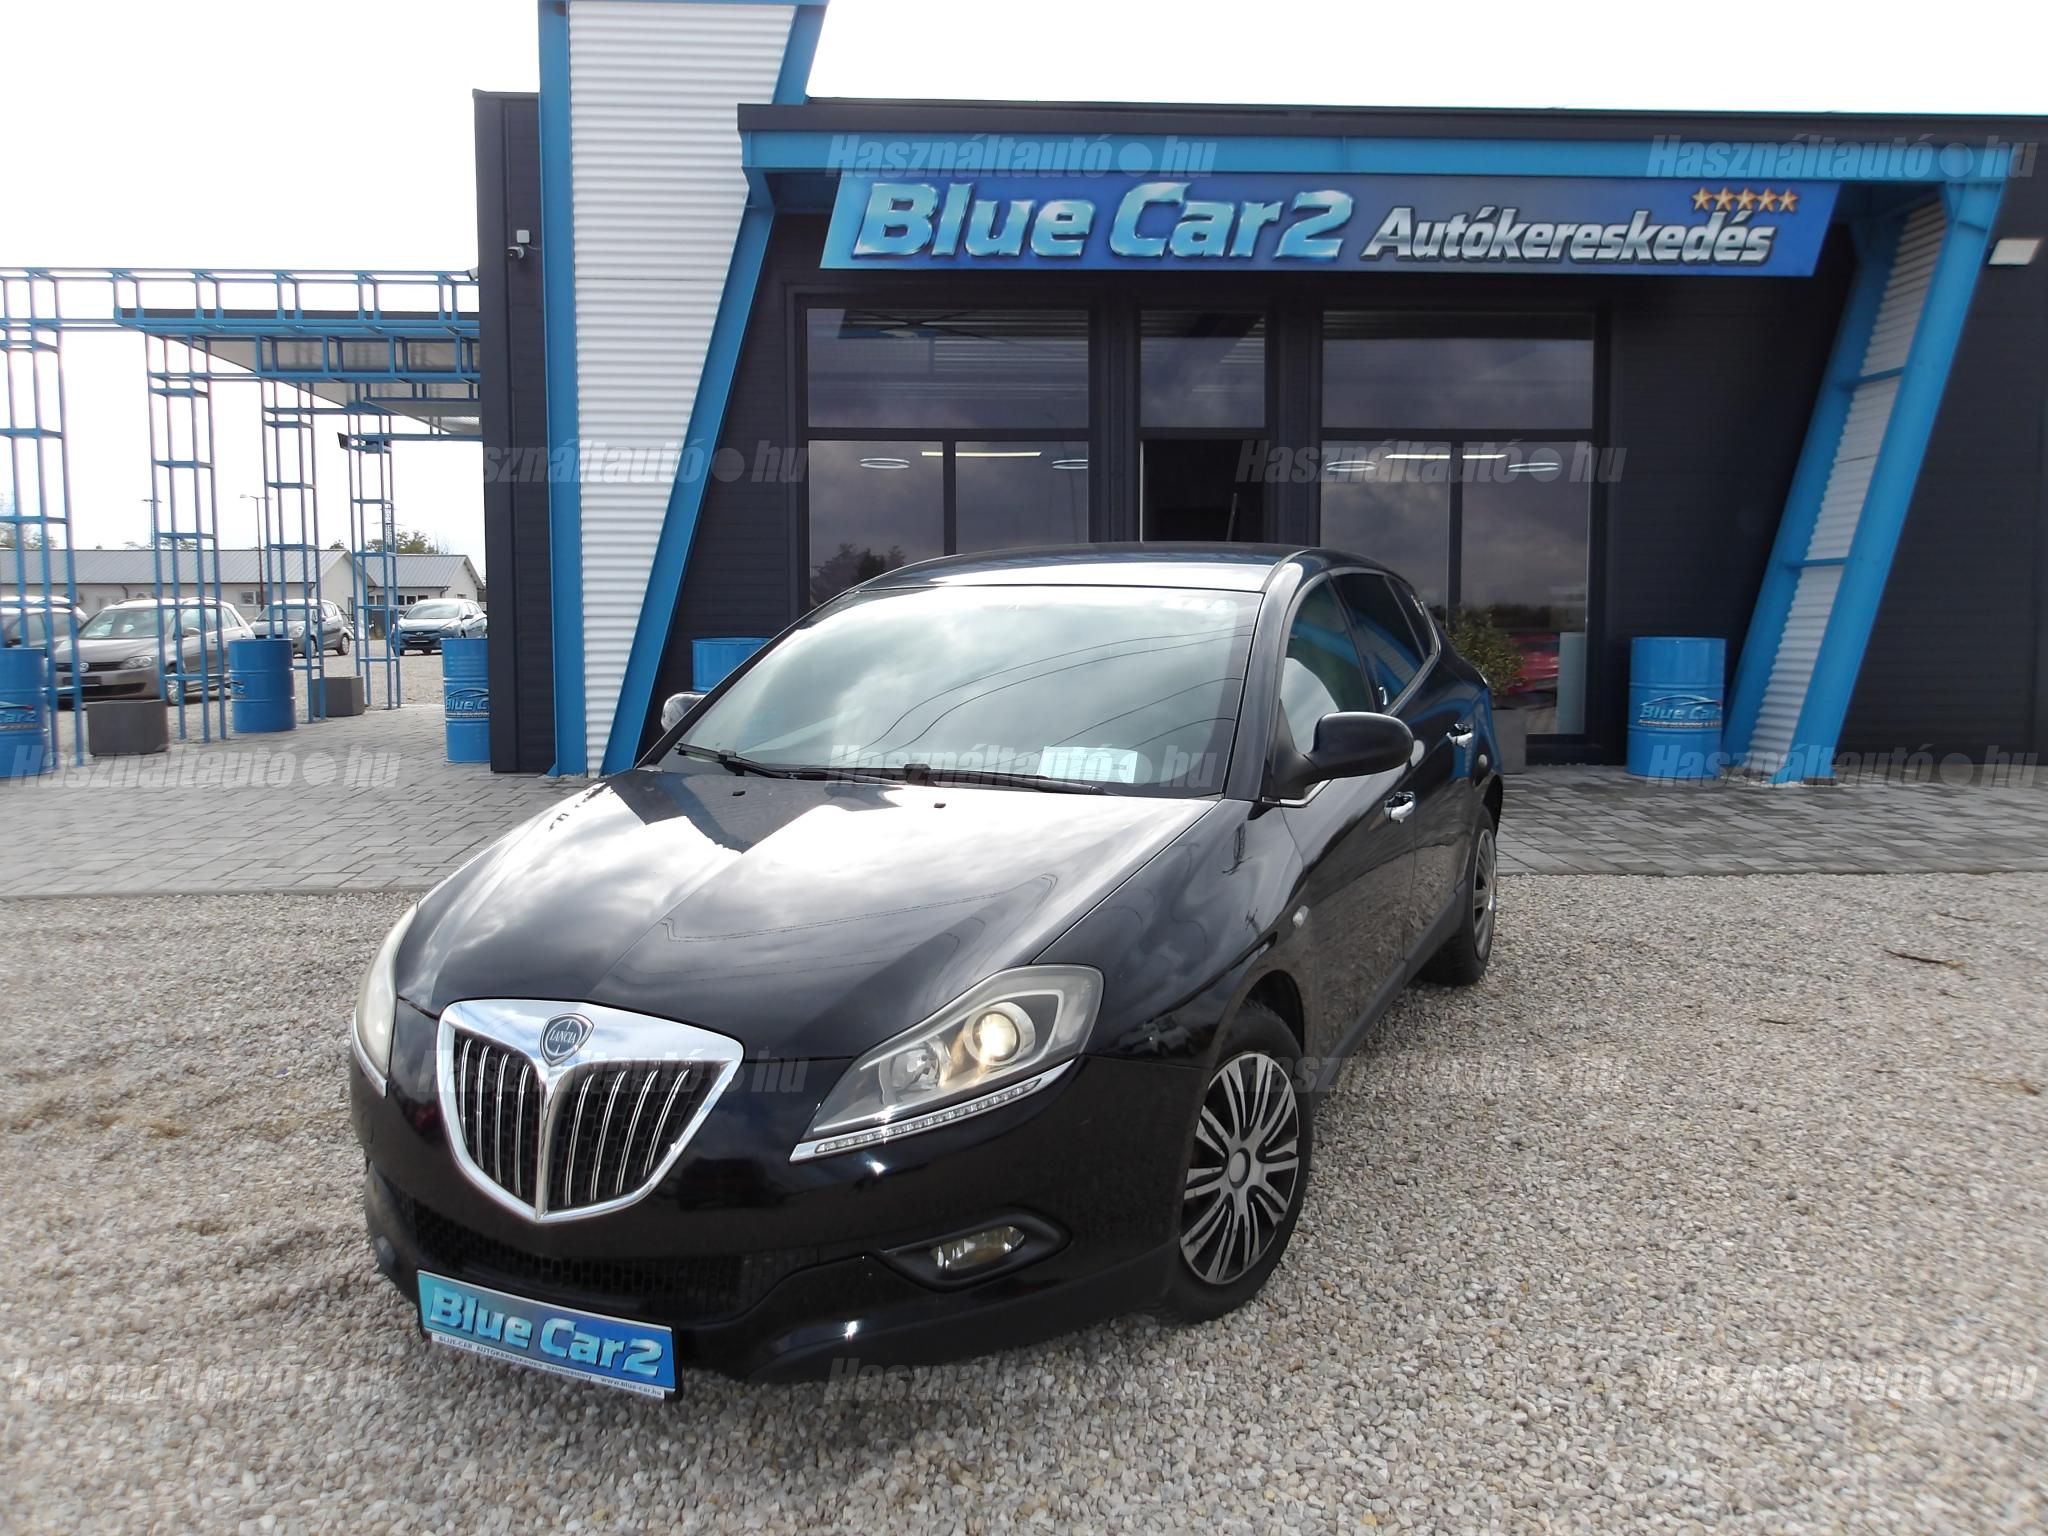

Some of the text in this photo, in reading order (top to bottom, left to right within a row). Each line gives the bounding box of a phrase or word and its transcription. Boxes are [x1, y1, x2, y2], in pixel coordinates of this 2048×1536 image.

[852, 182, 1354, 261] Blue Car2
[1359, 205, 1778, 265] Autókereskedés
[1640, 706, 1684, 719] Blue
[549, 1029, 577, 1044] LANCIA
[430, 1287, 663, 1377] Blue Car2
